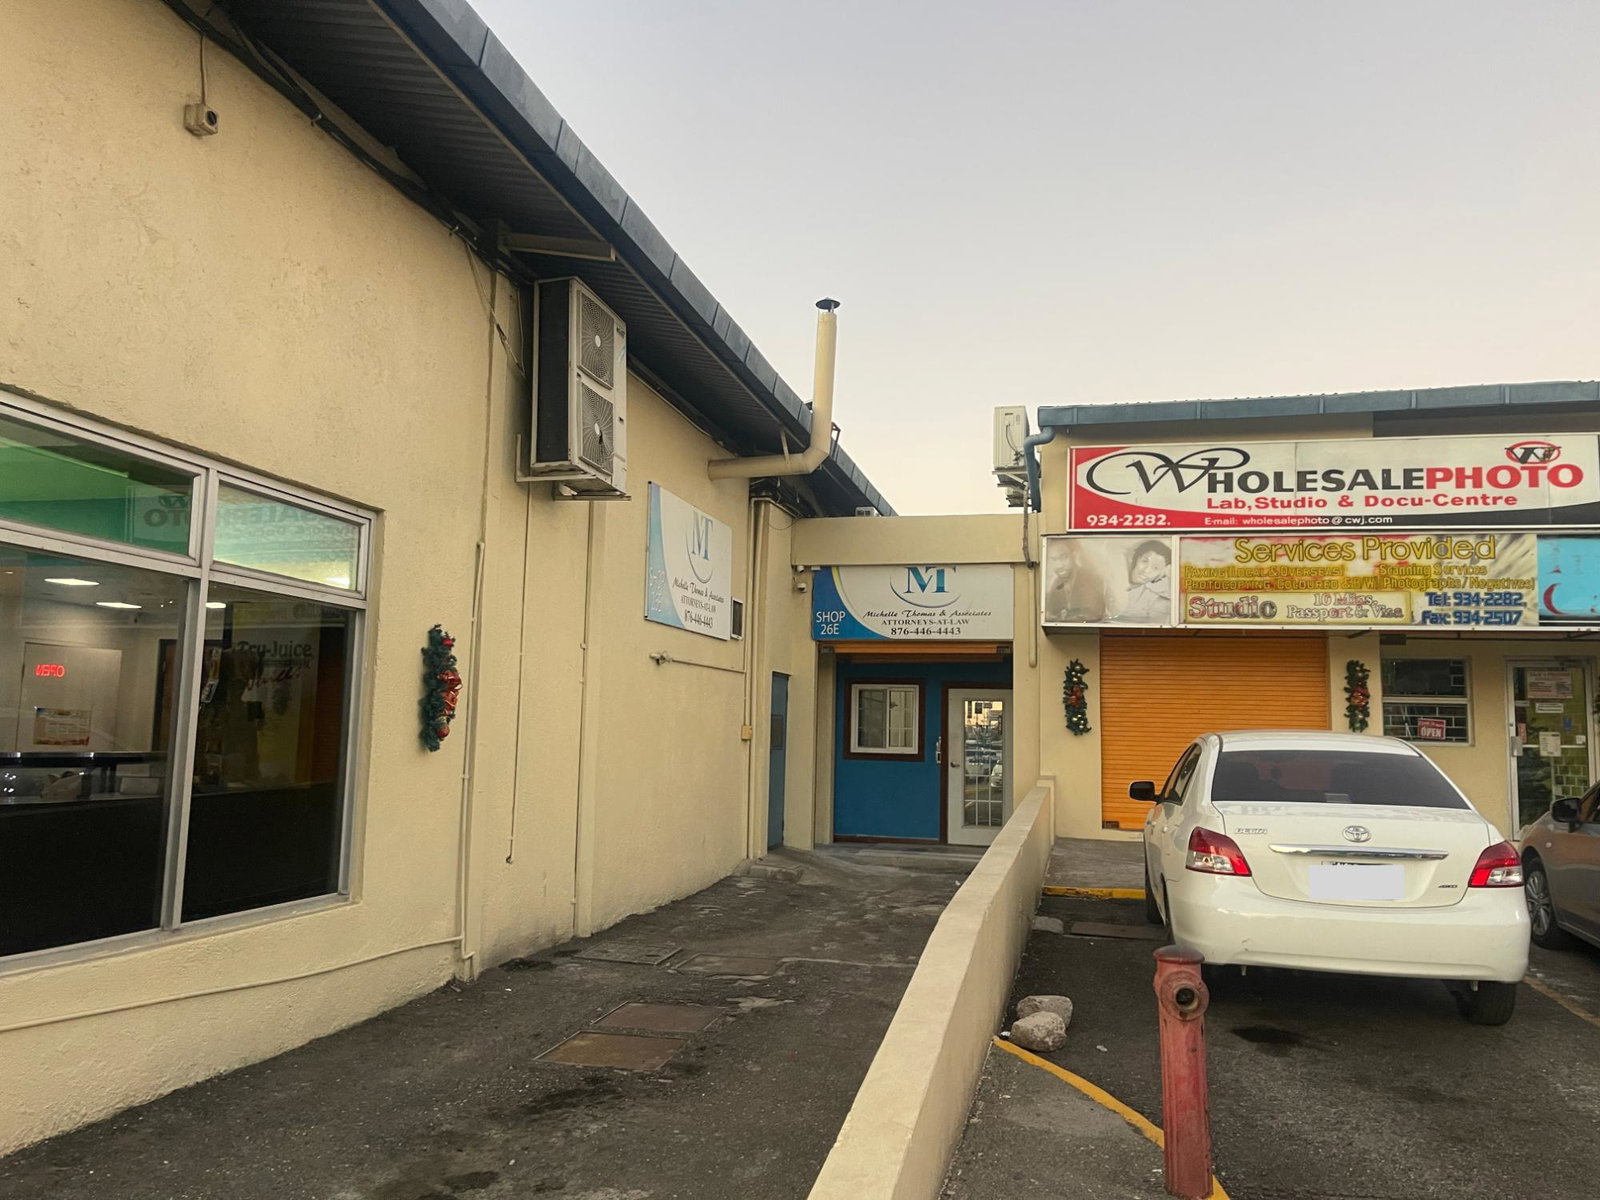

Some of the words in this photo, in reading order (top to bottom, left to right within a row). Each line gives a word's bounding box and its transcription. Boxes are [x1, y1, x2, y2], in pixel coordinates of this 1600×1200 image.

[1337, 495, 1354, 508] &
[1364, 493, 1518, 508] Docu-Centre
[1205, 517, 1238, 526] E-mail:
[1235, 536, 1356, 564] Services
[1362, 535, 1496, 561] Provided
[1379, 564, 1431, 577] Scanning
[1433, 564, 1488, 575] Services
[1313, 593, 1332, 606] 10
[862, 609, 899, 619] Michelle
[901, 609, 936, 619] Thomas
[949, 609, 992, 619] Associates
[1189, 596, 1278, 619] Studio
[1287, 605, 1354, 621] Passport
[1370, 604, 1404, 618] Visa
[816, 610, 846, 623] SHOP
[881, 618, 970, 626] ATTORNEYS-AT-LAW
[1452, 610, 1523, 625] 934-2507
[820, 623, 840, 635] 26E
[891, 627, 961, 636] 876-446-4443
[1421, 726, 1441, 737] OPEN
